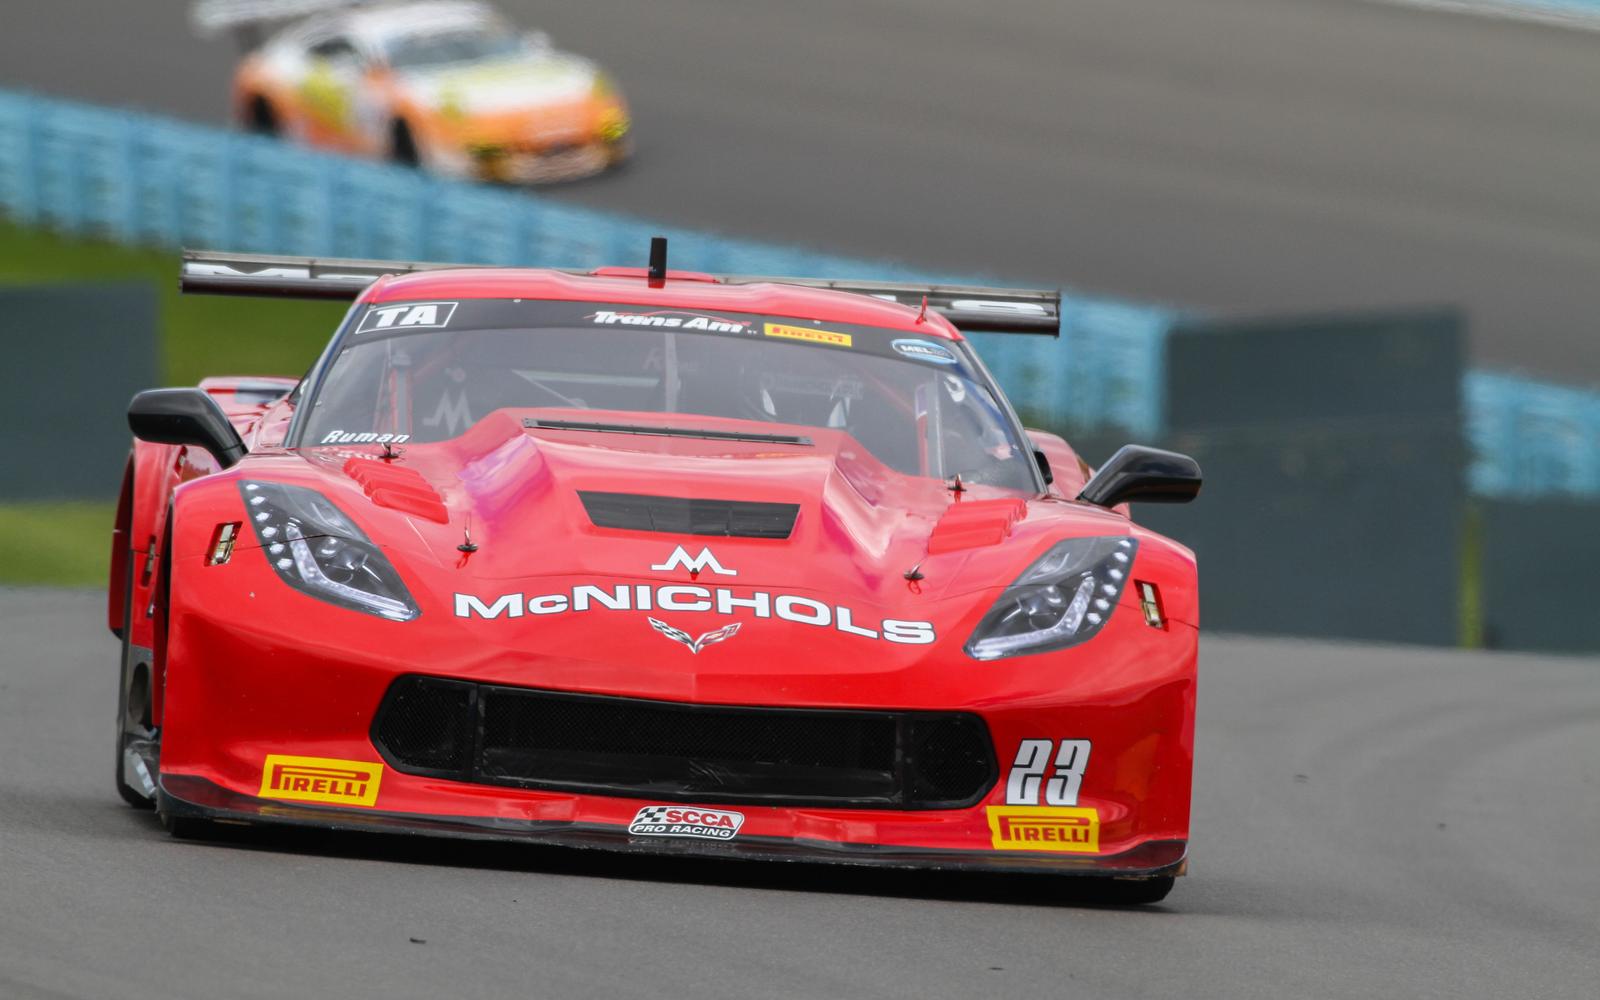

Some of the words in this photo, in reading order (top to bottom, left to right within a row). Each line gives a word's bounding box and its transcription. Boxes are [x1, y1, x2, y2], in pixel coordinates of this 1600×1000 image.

[376, 305, 438, 328] TA
[594, 311, 677, 328] Trans
[682, 317, 745, 333] Am
[320, 429, 410, 444] Ruman
[453, 584, 937, 645] McNICHOLS
[269, 763, 372, 798] PIRELLI
[1005, 738, 1092, 806] 23
[664, 809, 736, 829] SCCA
[997, 814, 1091, 844] PIRELLI
[632, 824, 667, 833] PRO
[669, 824, 732, 838] RACING
